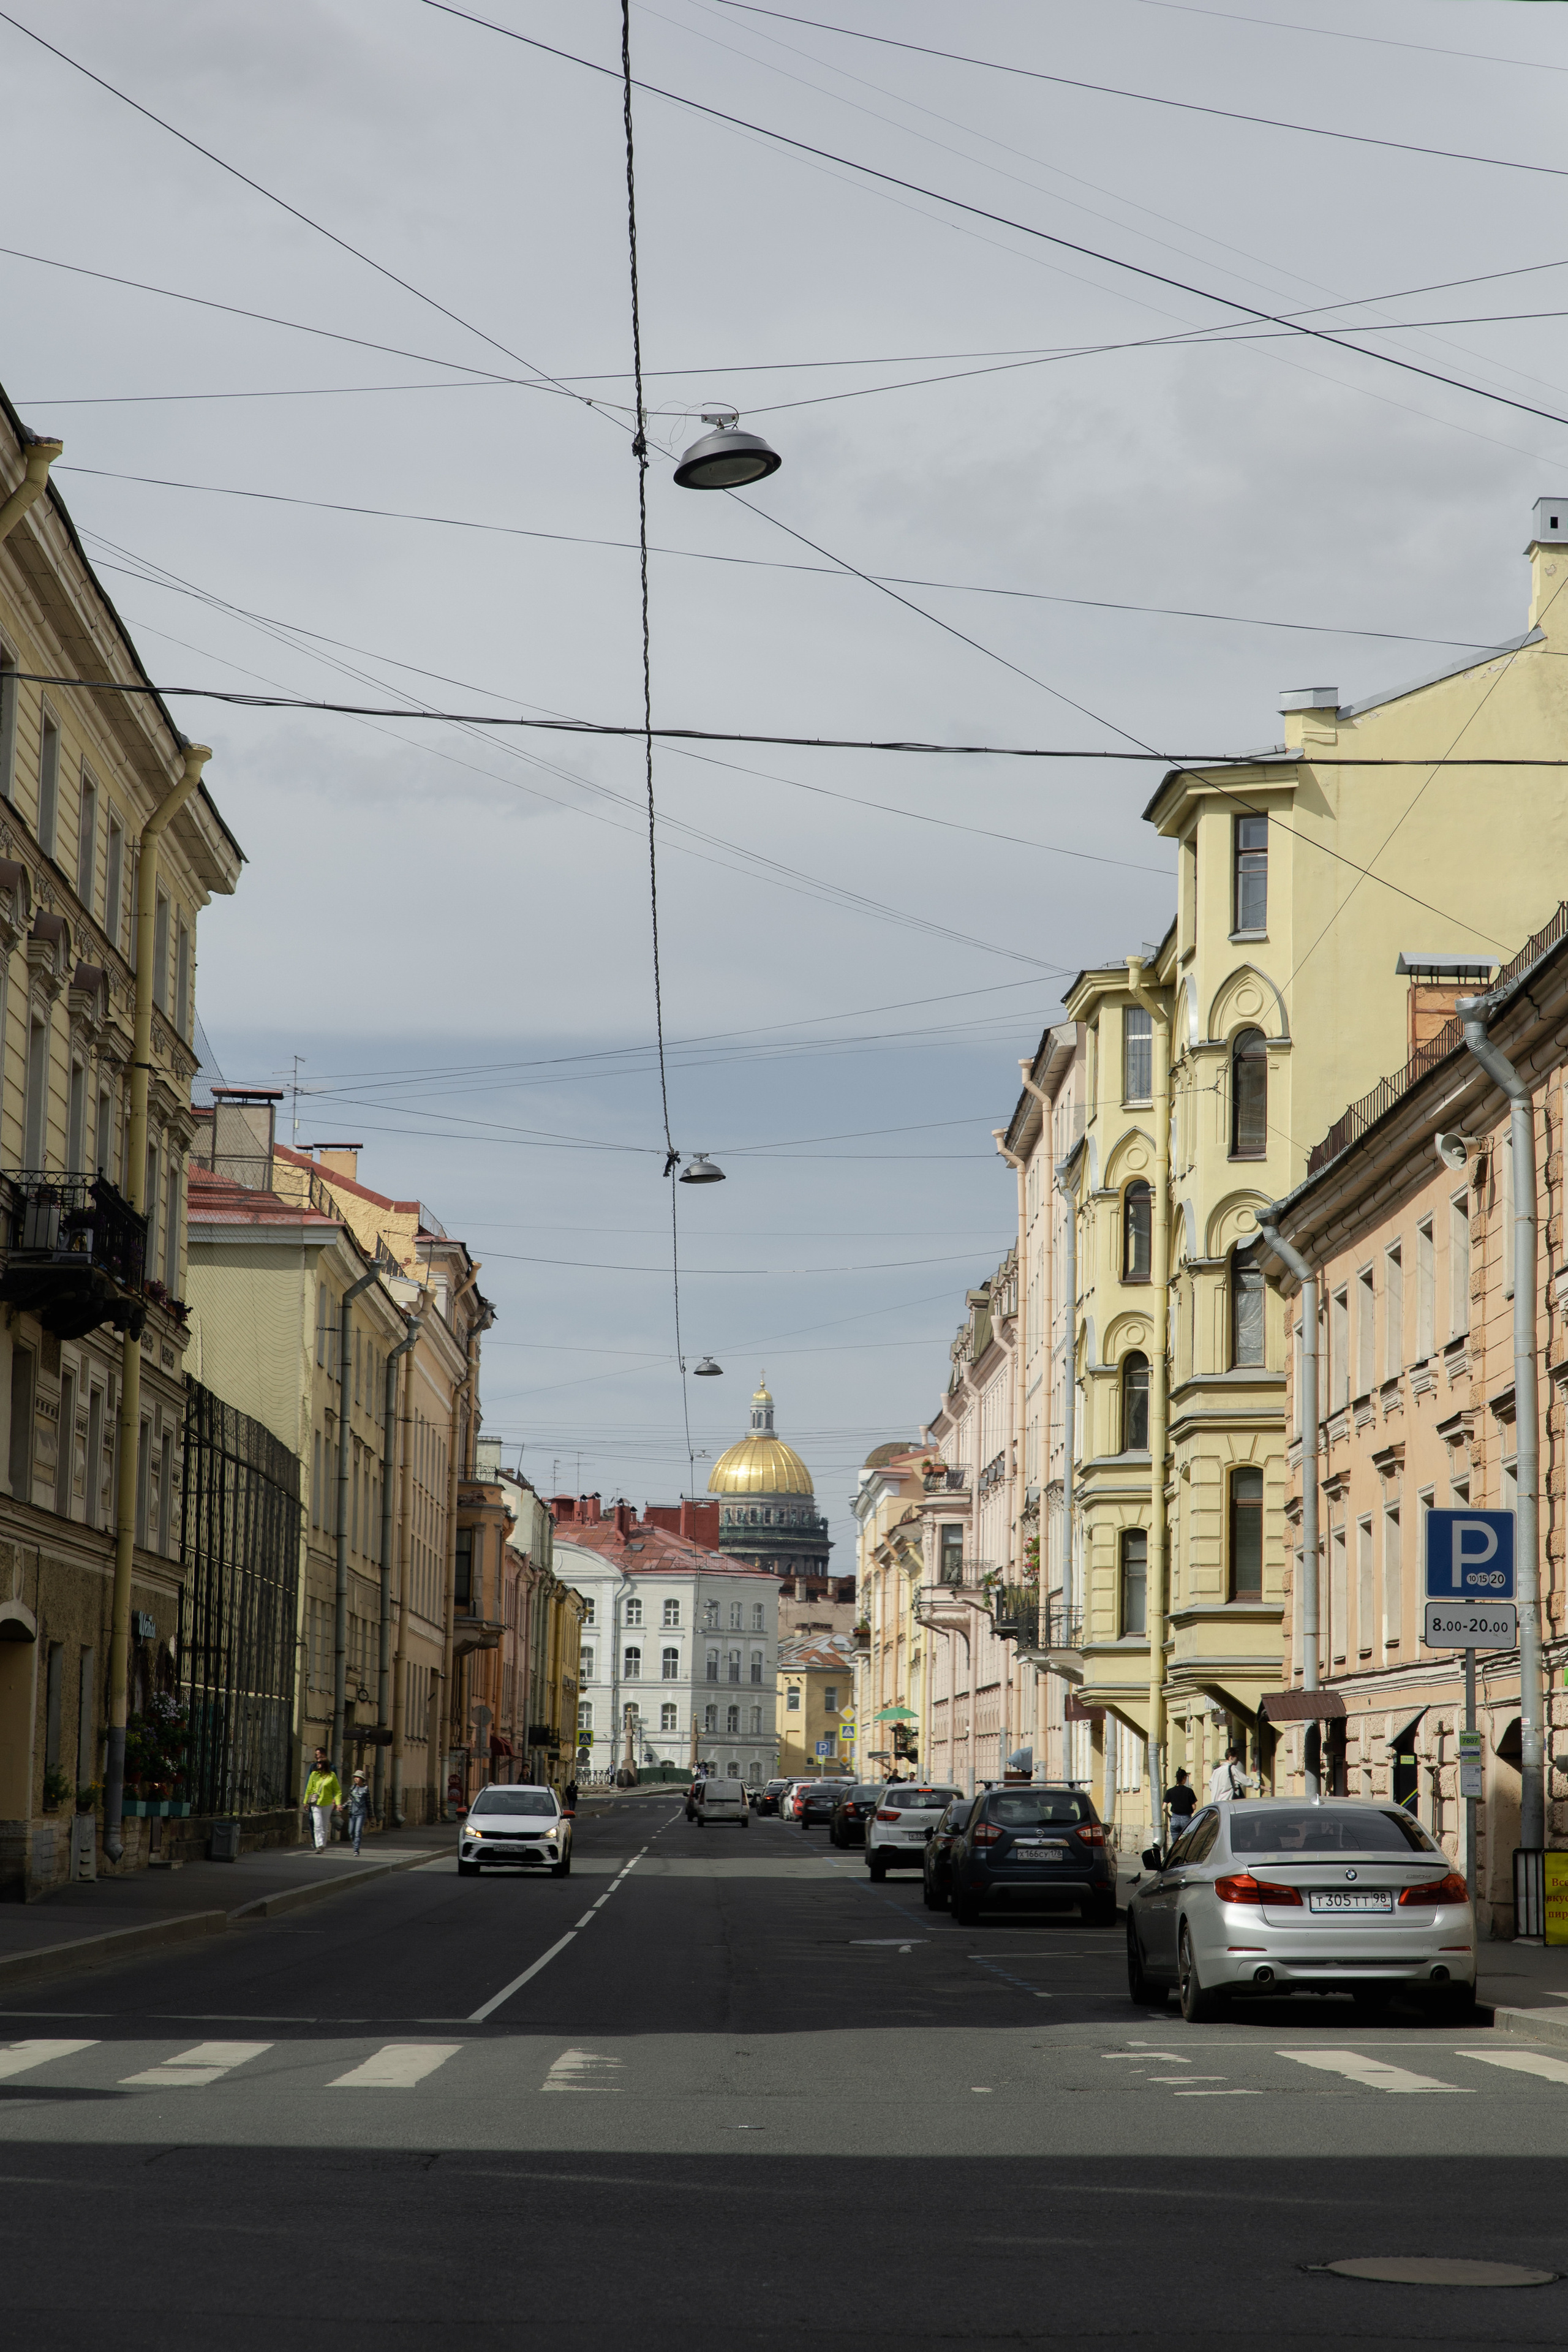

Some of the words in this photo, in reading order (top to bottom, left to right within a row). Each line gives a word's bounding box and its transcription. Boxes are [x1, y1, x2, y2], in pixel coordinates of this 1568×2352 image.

[1452, 1520, 1498, 1588] P
[1490, 1574, 1504, 1584] 20
[1433, 1618, 1508, 1633] 8.00-20.00
[819, 1743, 827, 1754] P
[1551, 1878, 1568, 1887] Все
[1373, 1893, 1387, 1903] 98
[1548, 1911, 1568, 1920] пир
